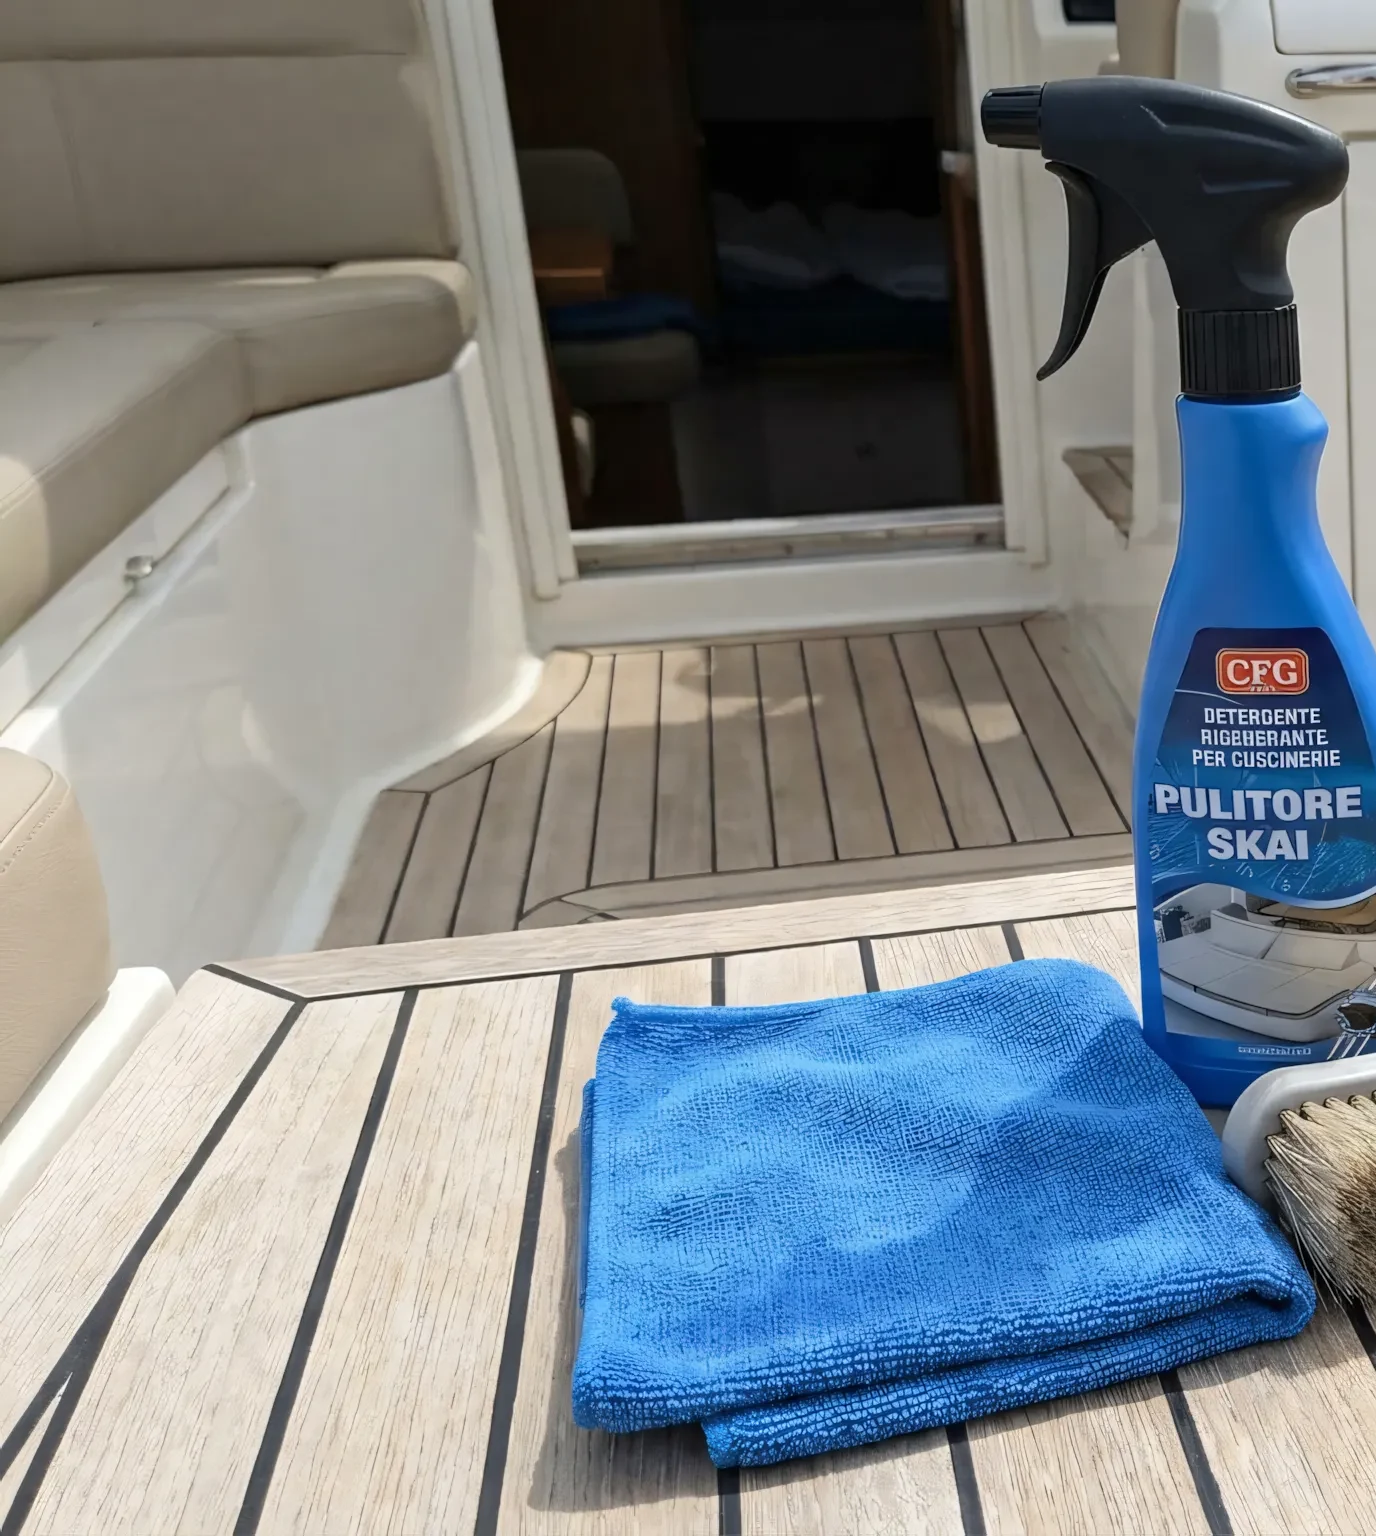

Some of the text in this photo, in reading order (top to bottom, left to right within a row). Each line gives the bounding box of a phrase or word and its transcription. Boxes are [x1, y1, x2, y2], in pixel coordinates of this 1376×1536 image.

[1226, 658, 1298, 686] CFG
[1203, 707, 1321, 725] DETERGENTE
[1192, 749, 1226, 768] PER
[1153, 783, 1363, 822] PULITORE
[1206, 827, 1309, 861] SKAI
